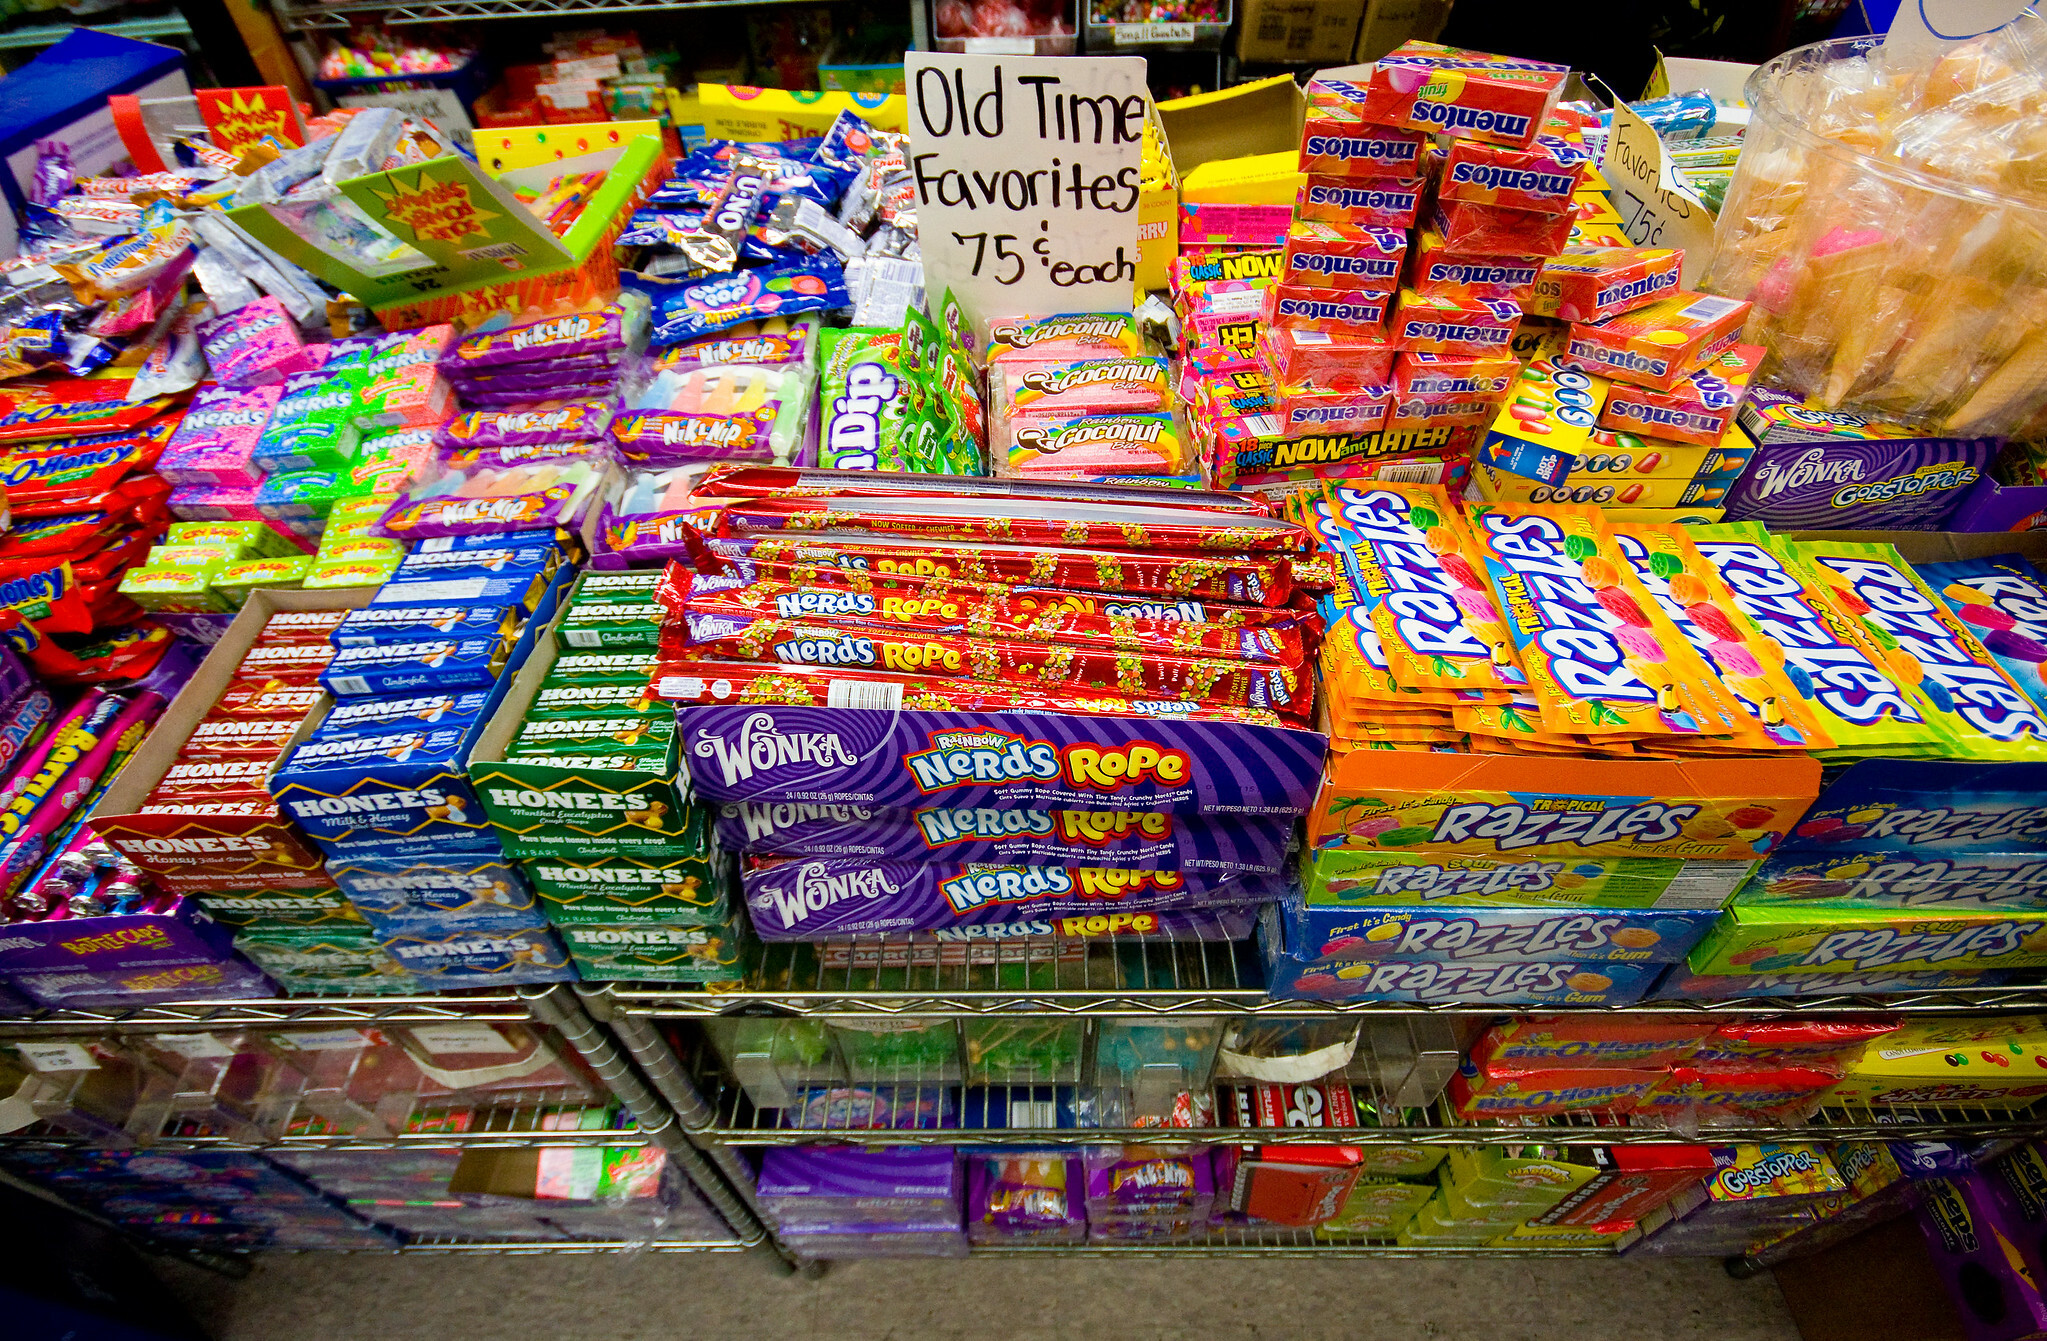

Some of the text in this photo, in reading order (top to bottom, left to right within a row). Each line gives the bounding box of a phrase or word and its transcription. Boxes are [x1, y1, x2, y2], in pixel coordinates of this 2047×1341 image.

[915, 65, 1145, 145] Old Time
[1410, 100, 1530, 137] mentos
[1307, 136, 1417, 161] mentos
[913, 153, 1139, 213] Favorites
[1453, 162, 1575, 195] mentos
[1310, 187, 1416, 212] mentos
[1050, 247, 1136, 288] each
[1292, 253, 1398, 278] mentos
[1430, 263, 1535, 286] mentos
[1596, 266, 1680, 309] mentos
[1279, 299, 1381, 324] mentos
[1077, 336, 1107, 345] Bar
[1568, 340, 1667, 377] mentos
[1112, 382, 1142, 390] Bar
[1408, 375, 1507, 393] mentos
[828, 362, 899, 454] Dip
[1611, 400, 1721, 433] mentos
[1112, 441, 1144, 450] Bar
[1236, 426, 1453, 466] CLASSIC NOW and LATER
[1237, 438, 1257, 451] 18
[1104, 476, 1171, 487] Rainbow
[1755, 447, 1867, 500] WONKA
[1530, 485, 1615, 503] DOTS
[1832, 467, 1979, 508] GOBSTOPPER
[871, 520, 889, 528] NOW
[892, 521, 916, 532] SOFTER
[927, 524, 955, 533] CHEWIER
[405, 548, 507, 564] HONEES
[1351, 540, 1392, 597] TROPICAL
[347, 608, 460, 622] HONEES
[1499, 575, 1544, 636] TROPICAL
[336, 641, 449, 661] HONEES
[332, 695, 448, 718] HONEES
[198, 720, 302, 736] HONEES
[524, 719, 641, 735] HONEES
[293, 733, 420, 759] HONEES
[695, 713, 857, 787] WONKA
[167, 761, 274, 779] HONEES
[289, 789, 446, 818] HONEES
[488, 789, 649, 811] HONEES
[1052, 789, 1076, 797] Covered
[1078, 791, 1093, 799] With
[1534, 799, 1605, 812] TROPICAL
[321, 814, 355, 828] Milk
[369, 813, 410, 825] Honey
[116, 836, 270, 853] HONEES
[537, 867, 684, 884] HONEES
[200, 898, 340, 909] HONEES
[758, 862, 900, 930] WONKA
[62, 930, 125, 954] BOTTLE
[121, 925, 164, 944] CAPS
[572, 931, 708, 945] HONEES
[1329, 921, 1356, 937] First
[397, 938, 530, 958] HONEES
[1724, 1149, 1820, 1194] GOBSTOPPER
